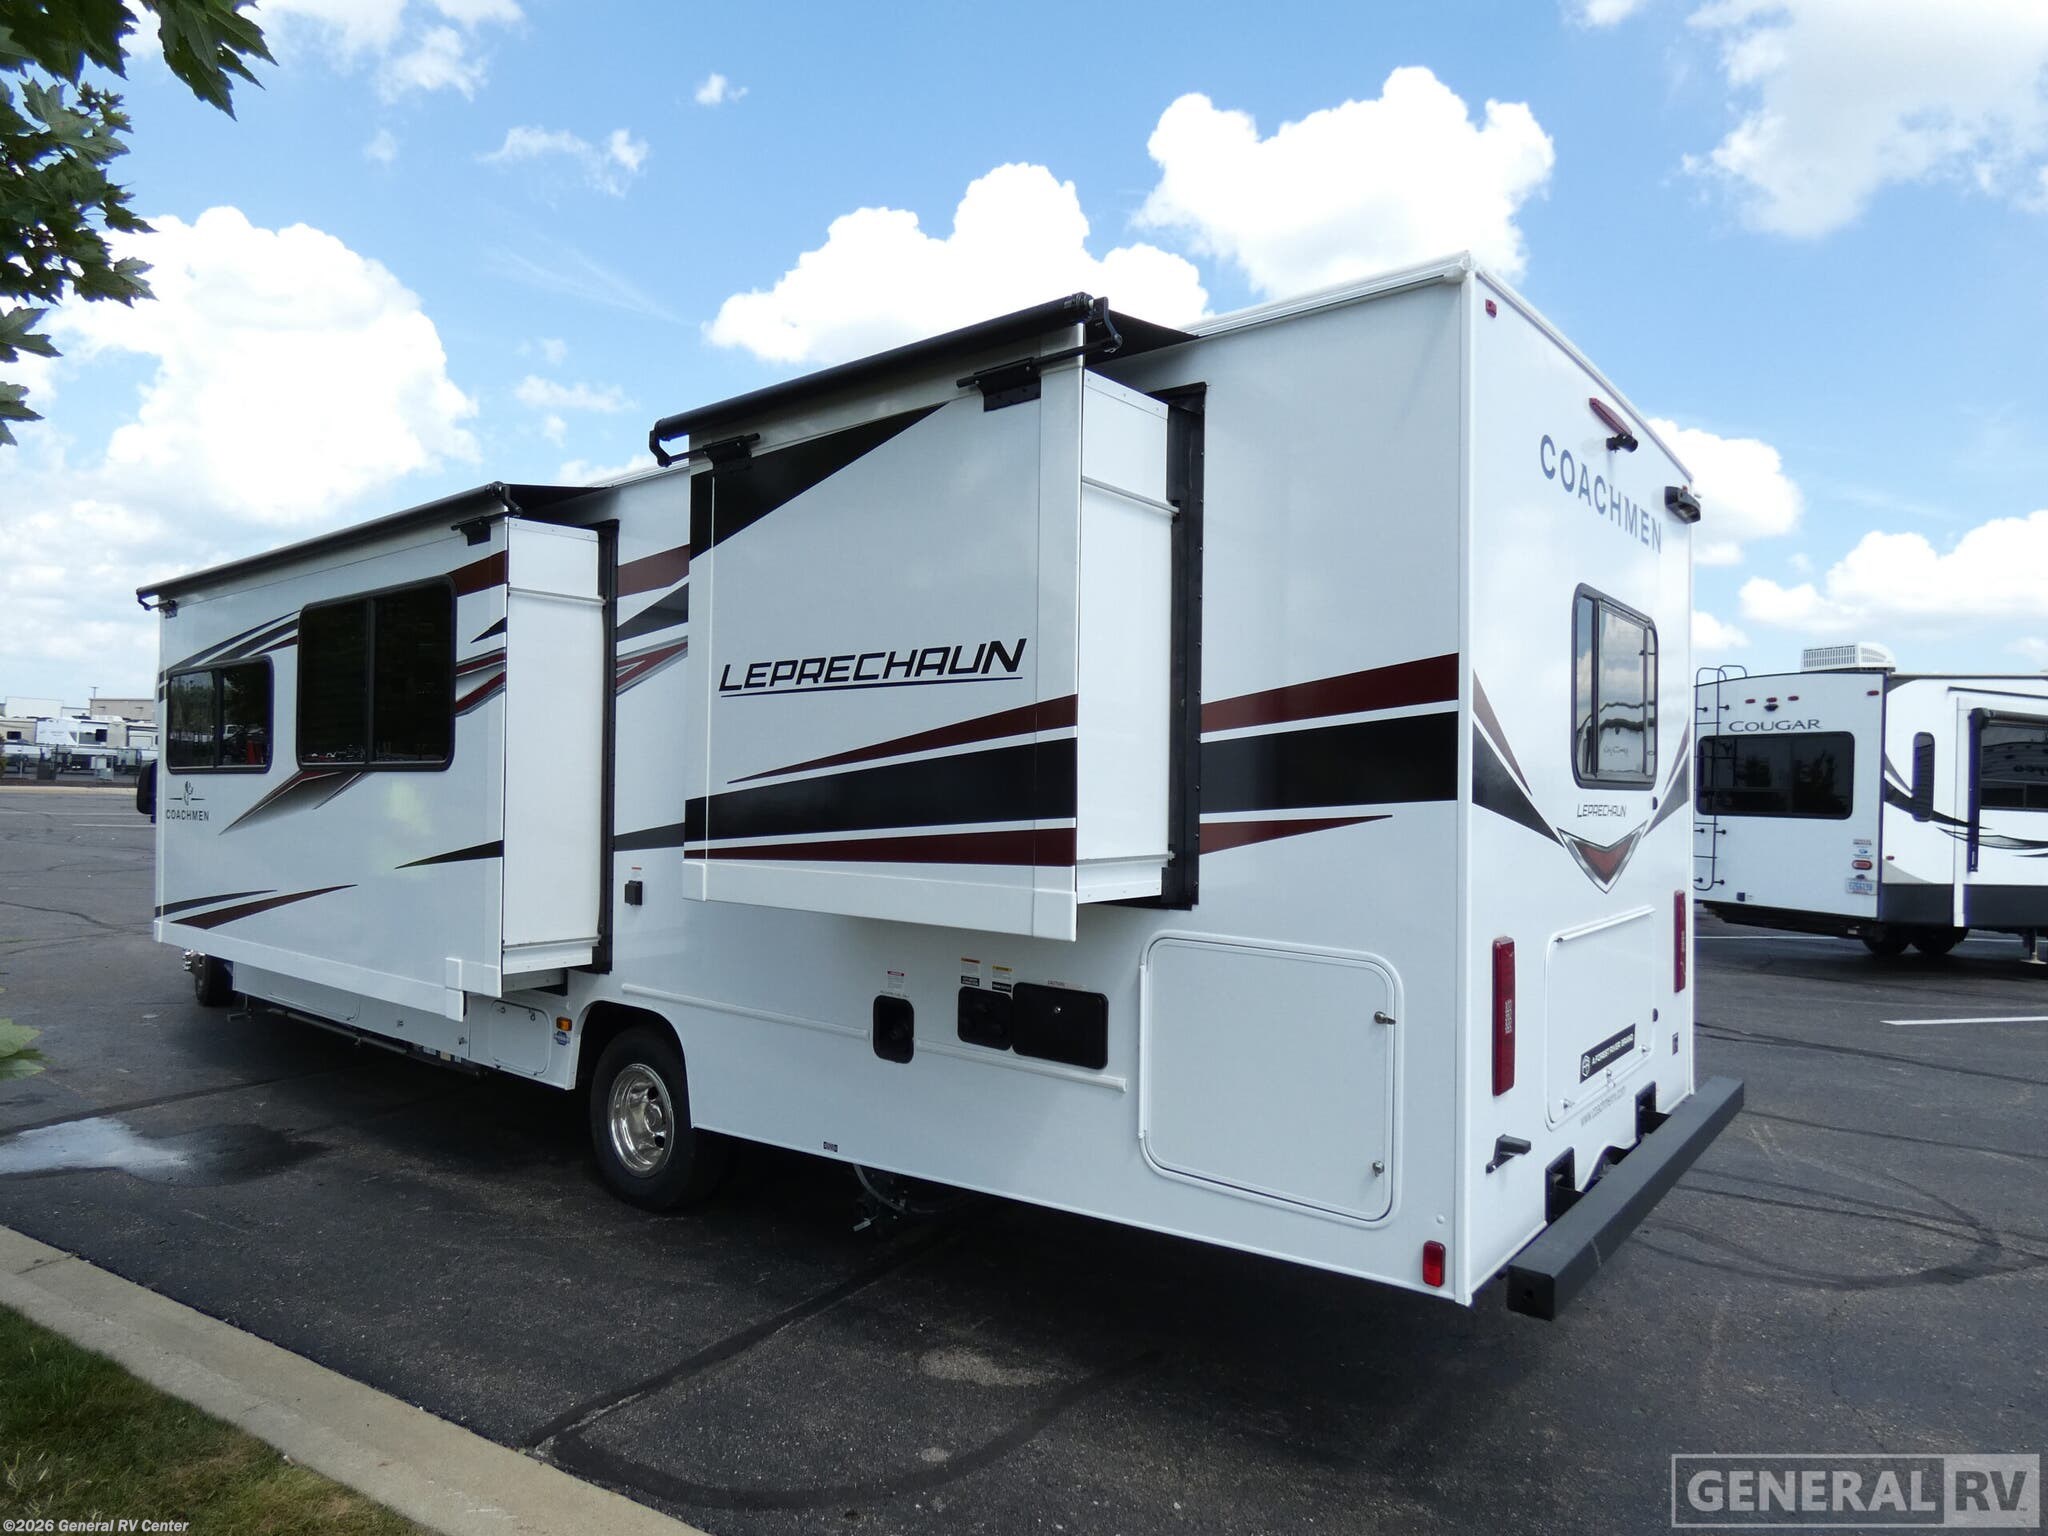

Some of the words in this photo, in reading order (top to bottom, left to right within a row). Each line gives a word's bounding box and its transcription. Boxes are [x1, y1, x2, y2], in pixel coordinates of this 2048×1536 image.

[1540, 434, 1661, 554] COACHMEN
[718, 638, 1027, 692] LEPRECHAUN
[1728, 719, 1820, 732] COUGAR
[165, 809, 209, 821] COACHMEN
[1576, 803, 1627, 818] LEPRECHAUN
